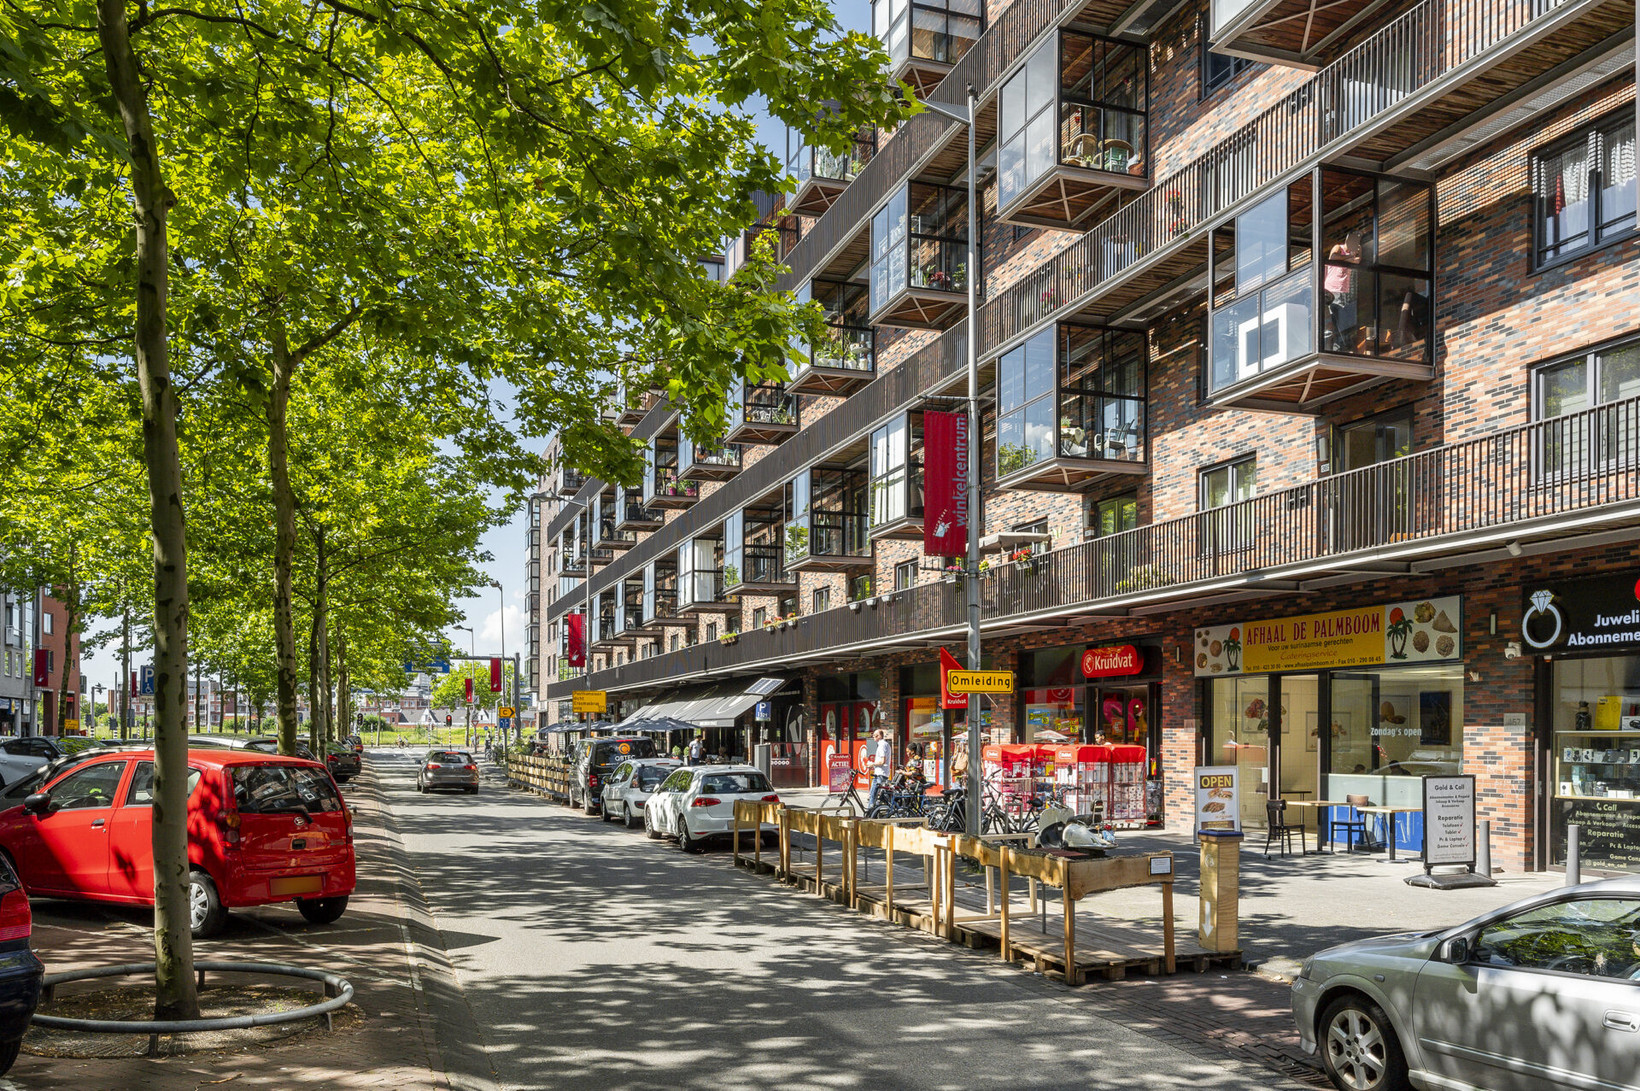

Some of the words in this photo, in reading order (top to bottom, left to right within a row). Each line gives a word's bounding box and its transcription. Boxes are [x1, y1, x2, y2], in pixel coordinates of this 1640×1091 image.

[952, 417, 967, 527] winkelcentrum
[1594, 609, 1640, 627] Juweli
[1246, 624, 1287, 646] AFHAAL
[1293, 621, 1307, 641] DE
[1314, 612, 1380, 639] PALMBOOM
[1267, 644, 1280, 652] Voor
[1323, 637, 1354, 648] gerechten
[1094, 653, 1133, 671] Kruidvat
[951, 675, 1010, 689] Omleiding
[759, 702, 767, 712] P
[1370, 727, 1402, 738] Zondag's
[1403, 728, 1422, 738] open
[1201, 775, 1232, 788] OPEN
[1602, 804, 1618, 812] Call
[1437, 814, 1464, 822] Reparatie
[1592, 820, 1617, 828] Verkoop
[1587, 829, 1625, 839] Reparatie
[1609, 853, 1627, 861] Game
